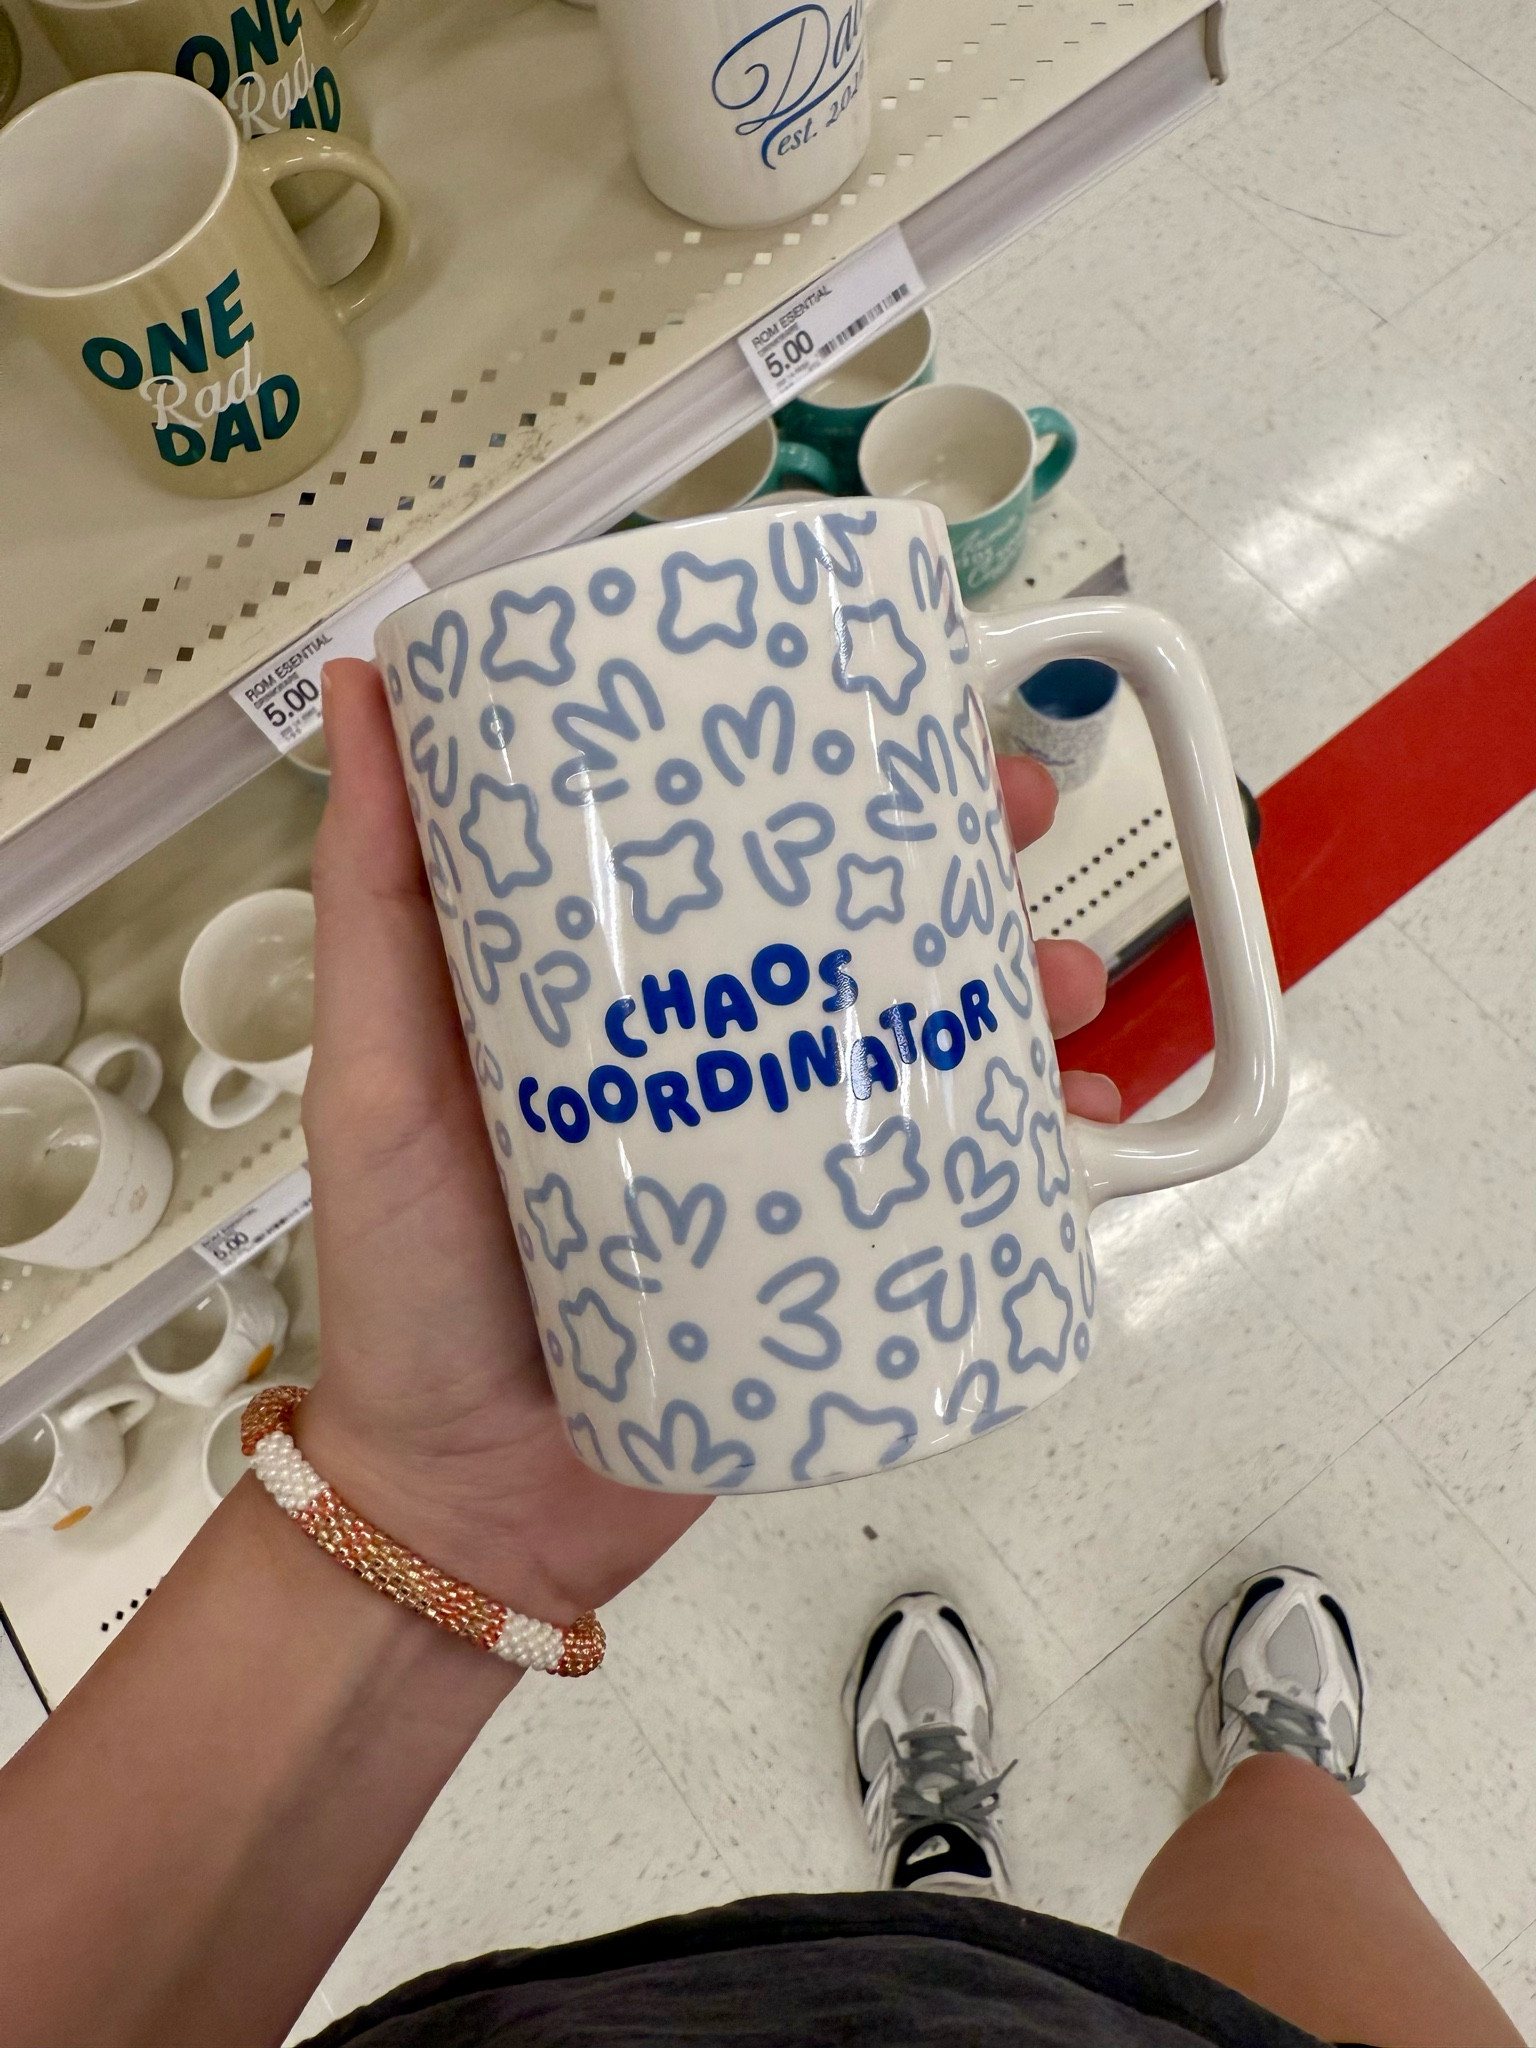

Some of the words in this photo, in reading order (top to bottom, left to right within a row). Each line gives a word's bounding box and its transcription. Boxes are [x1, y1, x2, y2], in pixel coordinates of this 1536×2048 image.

[227, 27, 316, 143] Rad
[777, 117, 818, 156] est.
[82, 268, 255, 391] ONE
[752, 323, 780, 349] ROM
[779, 284, 833, 329] ESENTIAL
[765, 329, 815, 379] 5.00
[139, 340, 262, 430] Rad
[152, 374, 301, 467] DAD
[245, 672, 277, 703] ROM
[276, 633, 333, 679] ESENTIAL
[263, 677, 320, 728] 5.00
[604, 943, 859, 1058] CHAOS
[518, 979, 998, 1144] COORDINATOR
